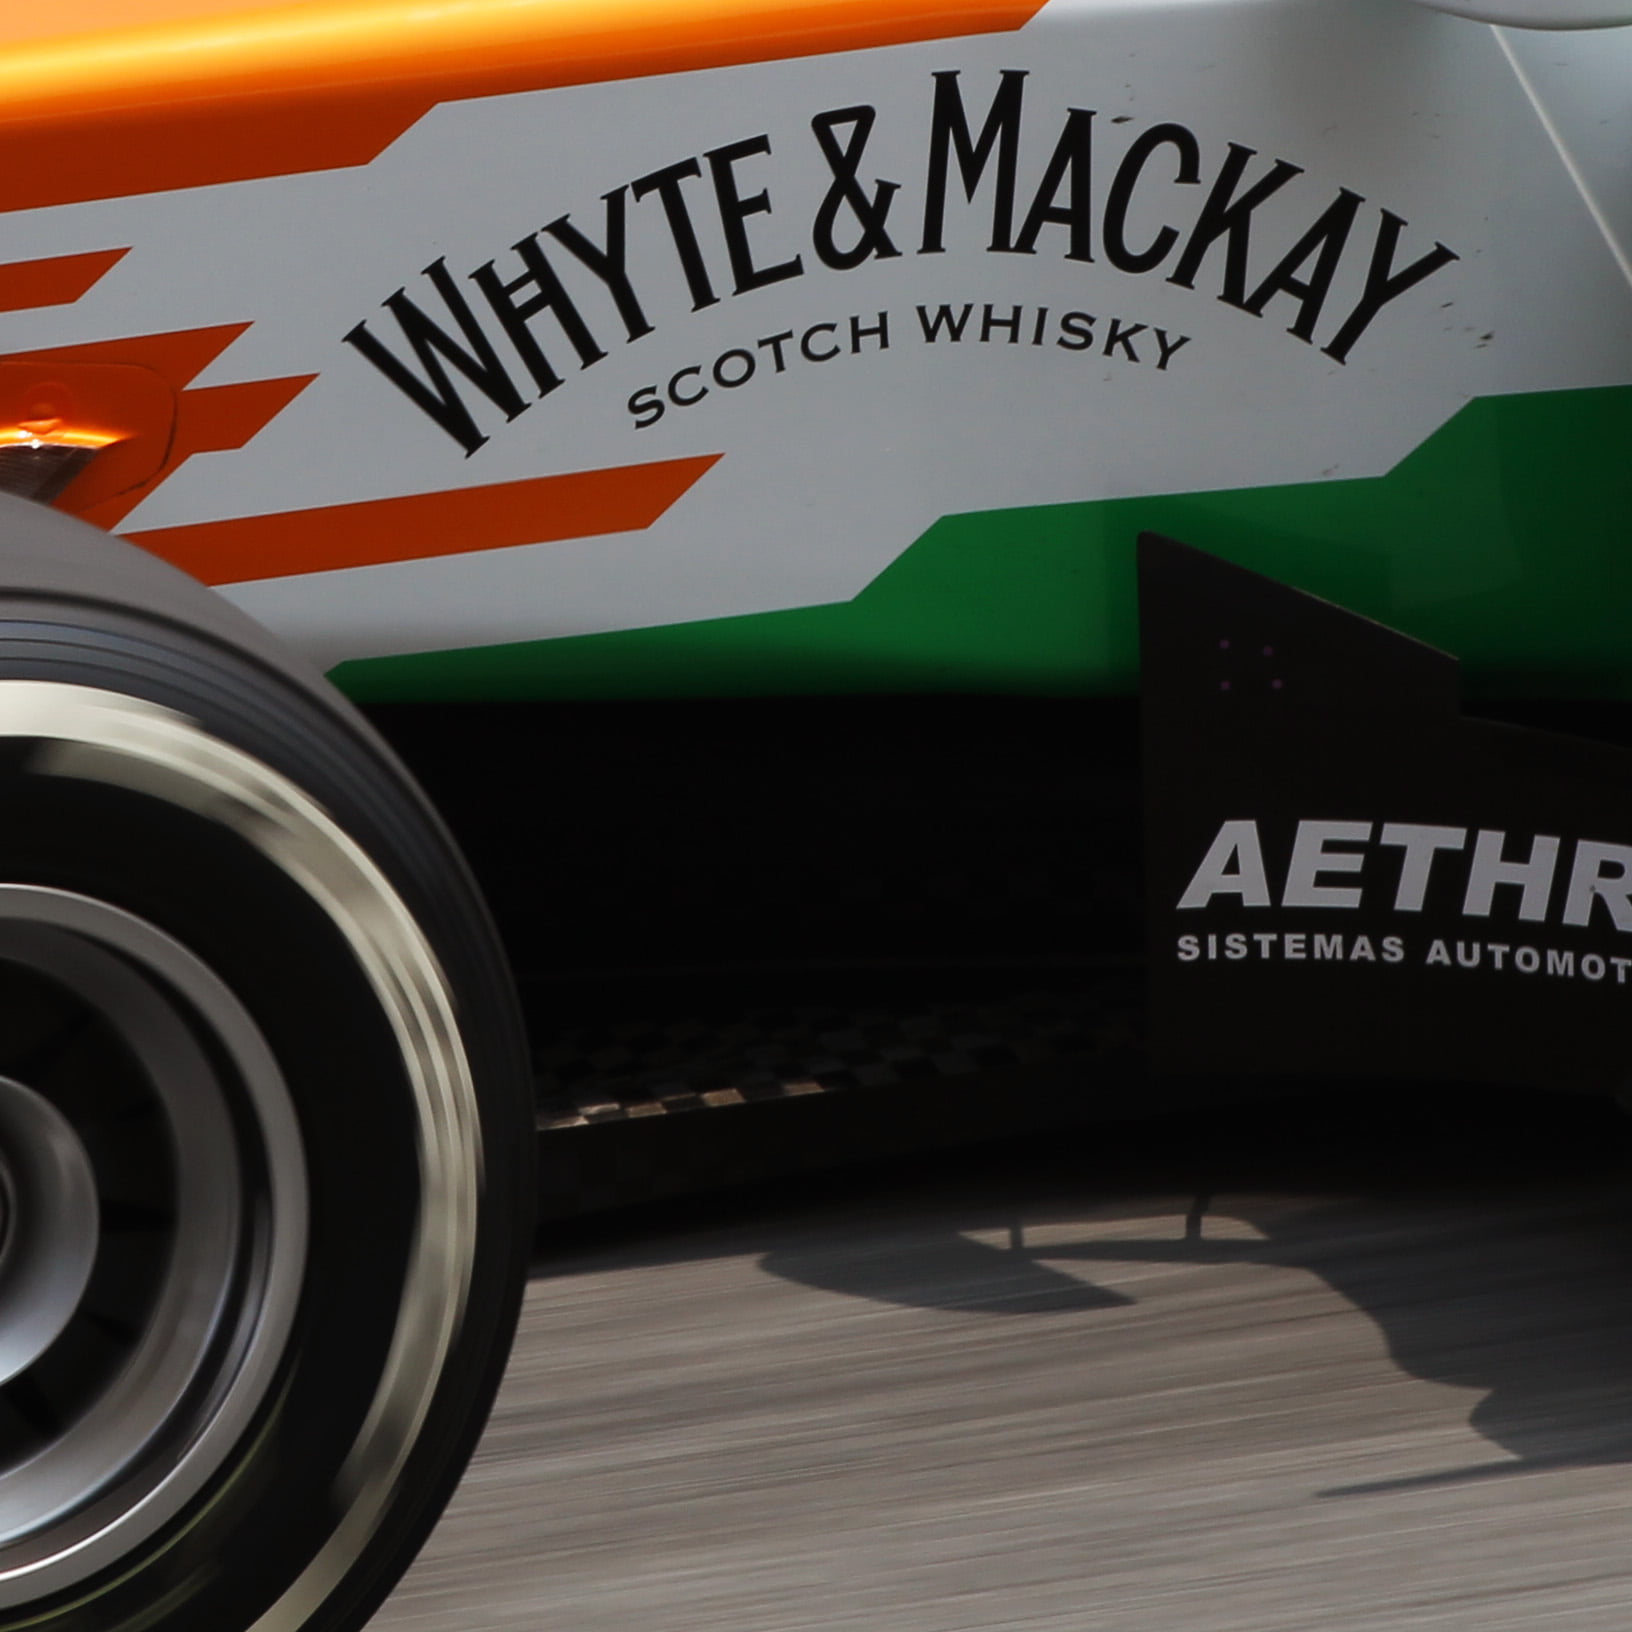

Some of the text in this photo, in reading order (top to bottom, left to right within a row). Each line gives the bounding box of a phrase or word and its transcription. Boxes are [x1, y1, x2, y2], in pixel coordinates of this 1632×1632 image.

[341, 69, 1460, 458] WHYTE & MACKAY
[627, 303, 1192, 430] SCOTCH WHISKY
[1177, 933, 1405, 963] SISTEMAS
